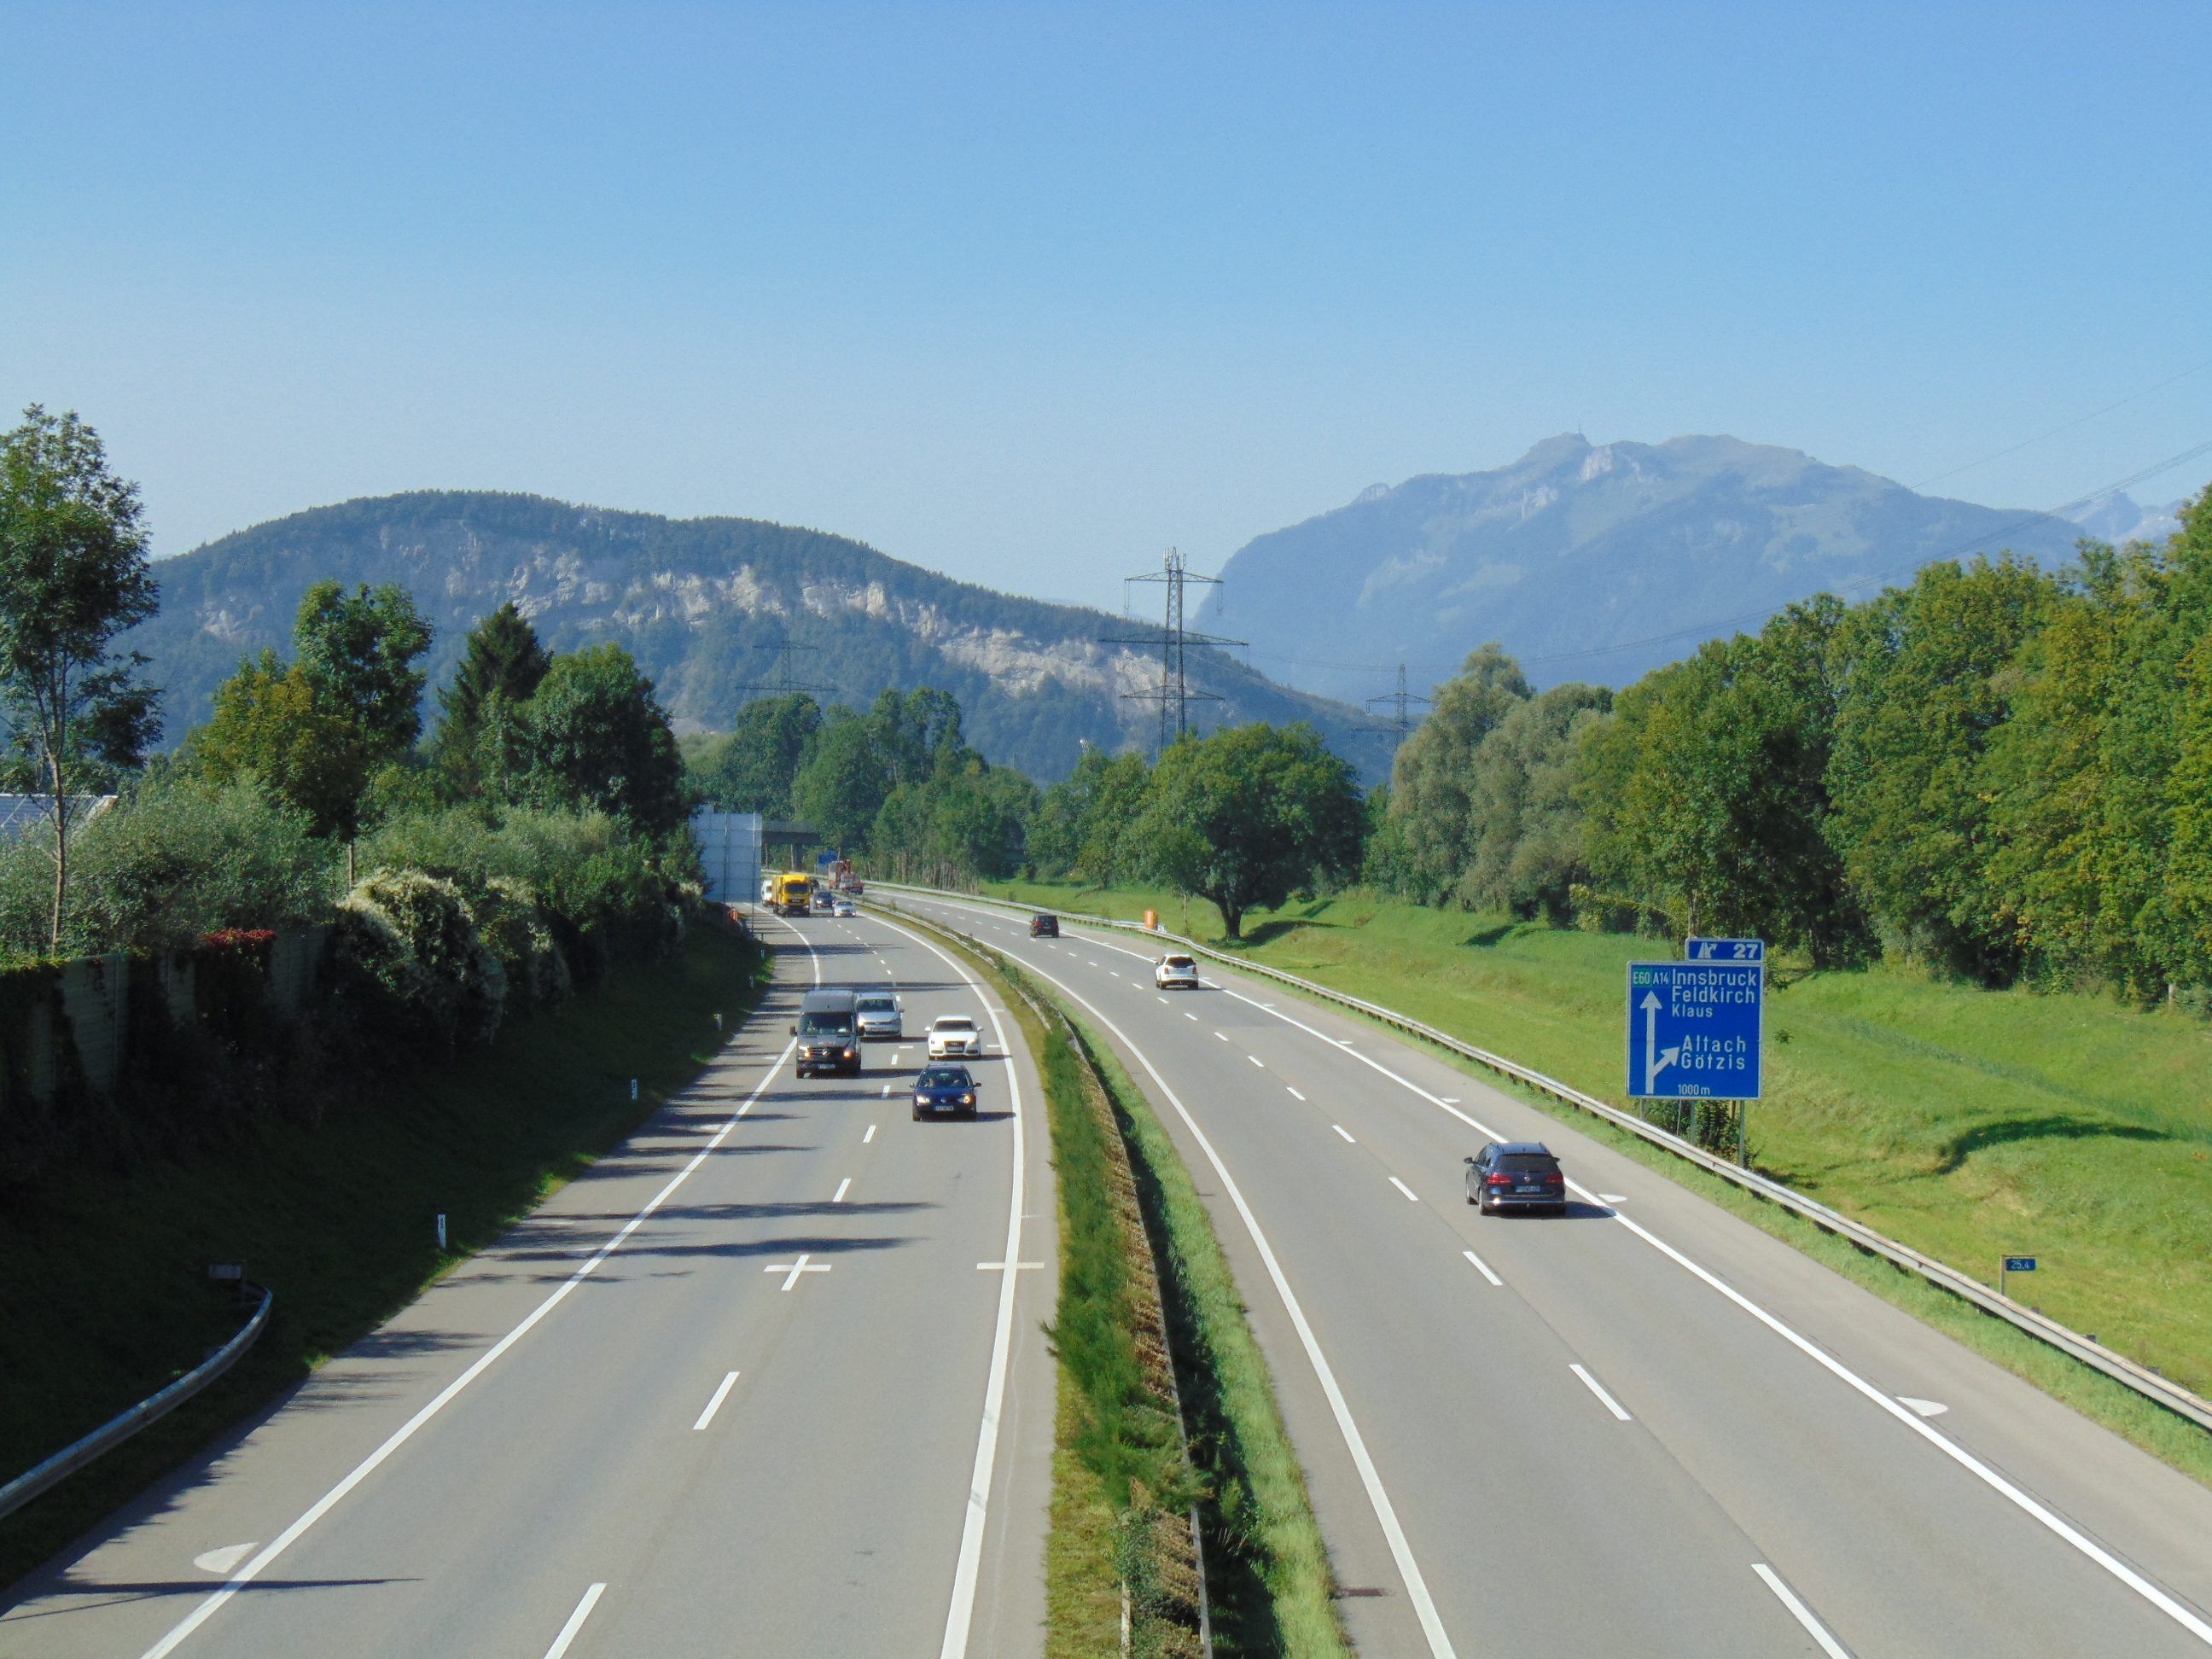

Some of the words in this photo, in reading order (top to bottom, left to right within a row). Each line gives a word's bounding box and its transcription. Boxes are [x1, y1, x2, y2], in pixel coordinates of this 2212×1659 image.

[1733, 943, 1758, 958] 27
[1633, 972, 1650, 985] E60
[1653, 972, 1669, 985] A14
[1672, 969, 1757, 987] Innsbruck
[1672, 986, 1755, 1004] Feldkirch
[1672, 1004, 1714, 1018] Klaus
[1682, 1034, 1747, 1053] Altach
[1681, 1052, 1746, 1070] Götzis
